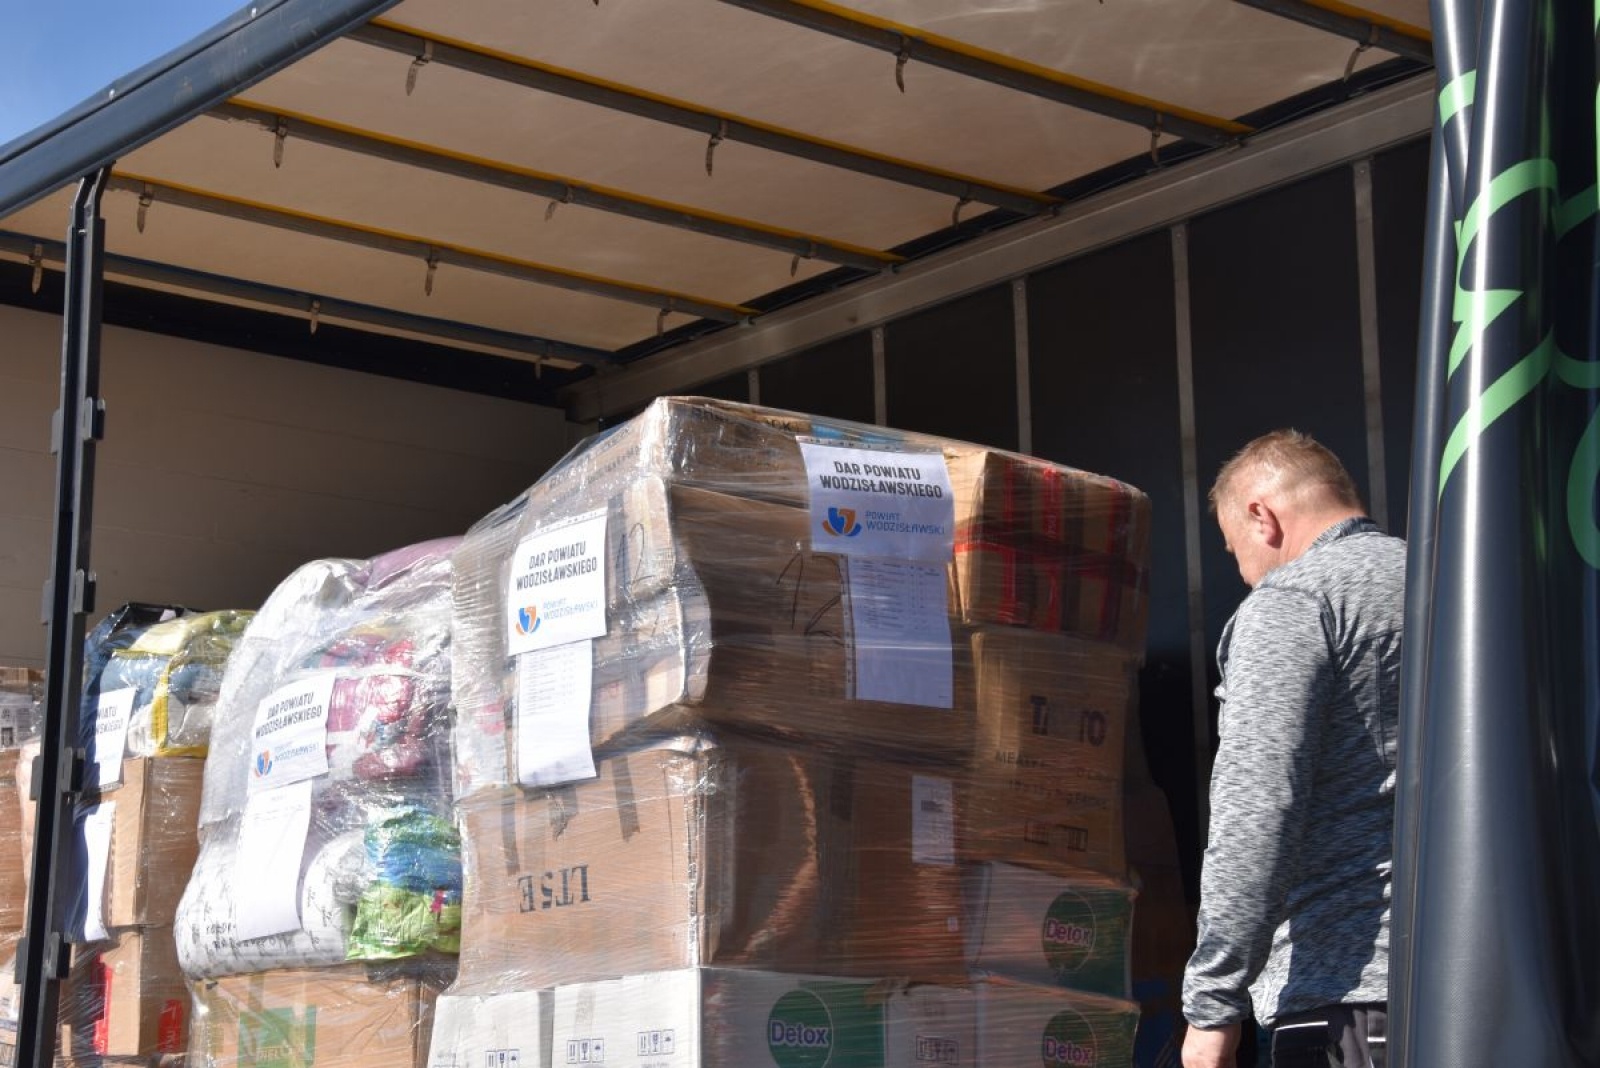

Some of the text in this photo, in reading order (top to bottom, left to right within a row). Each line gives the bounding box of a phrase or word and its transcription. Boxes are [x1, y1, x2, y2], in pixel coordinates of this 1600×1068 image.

[834, 460, 921, 480] DAR POWIATU
[820, 474, 943, 498] WODZISŁAWSKIEGO
[865, 510, 901, 521] POWIAT
[529, 540, 587, 570] DAR POWIATU
[516, 556, 598, 592] WODZISŁAWSKIEGO
[280, 691, 314, 713] POWIATU
[256, 704, 323, 739] WODZISŁAWSKIEGO
[1046, 918, 1091, 945] Detox
[770, 1021, 828, 1046] Detox
[1045, 1037, 1093, 1065] Detox
